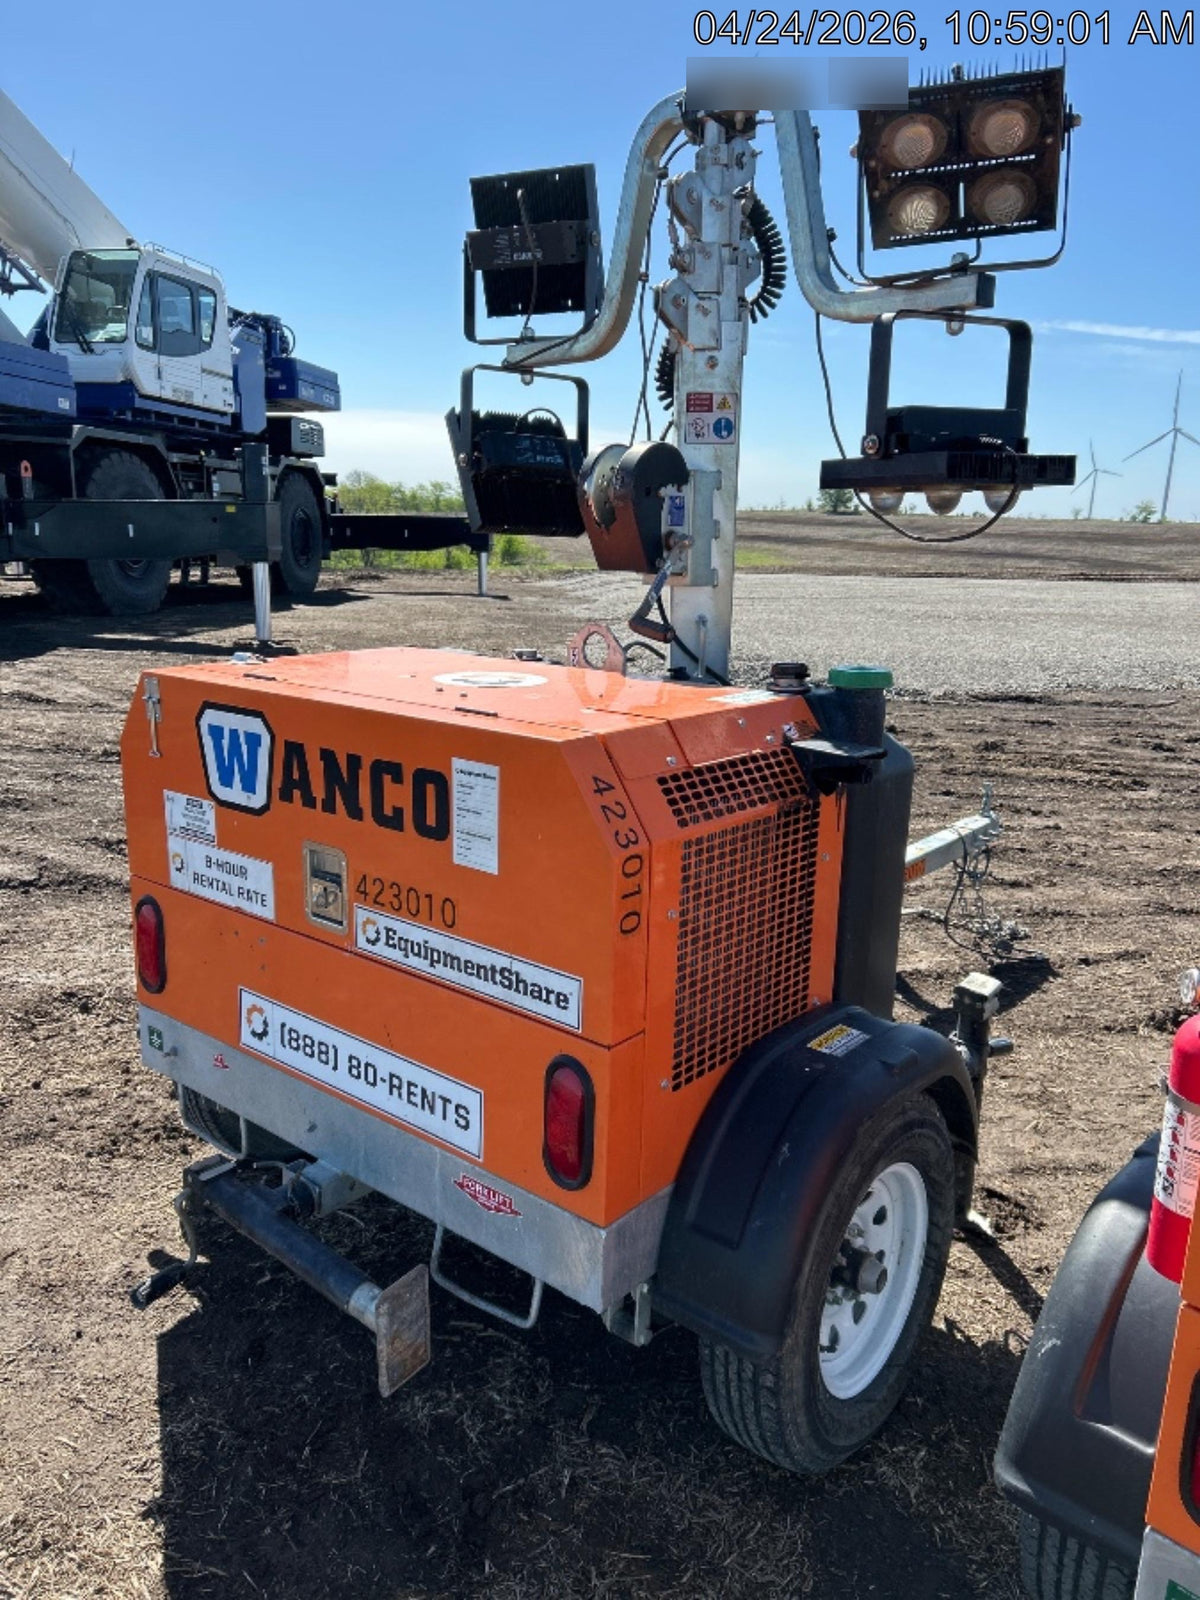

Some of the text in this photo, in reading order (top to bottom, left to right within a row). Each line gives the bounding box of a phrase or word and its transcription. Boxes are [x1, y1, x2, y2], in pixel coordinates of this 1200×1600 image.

[205, 716, 451, 842] WANCO
[193, 871, 267, 907] RENTAL RATE
[356, 874, 456, 929] 423010
[592, 775, 643, 935] 423010
[384, 926, 570, 1011] EquipmentShare
[279, 1021, 471, 1132] (888) 80-RENTS
